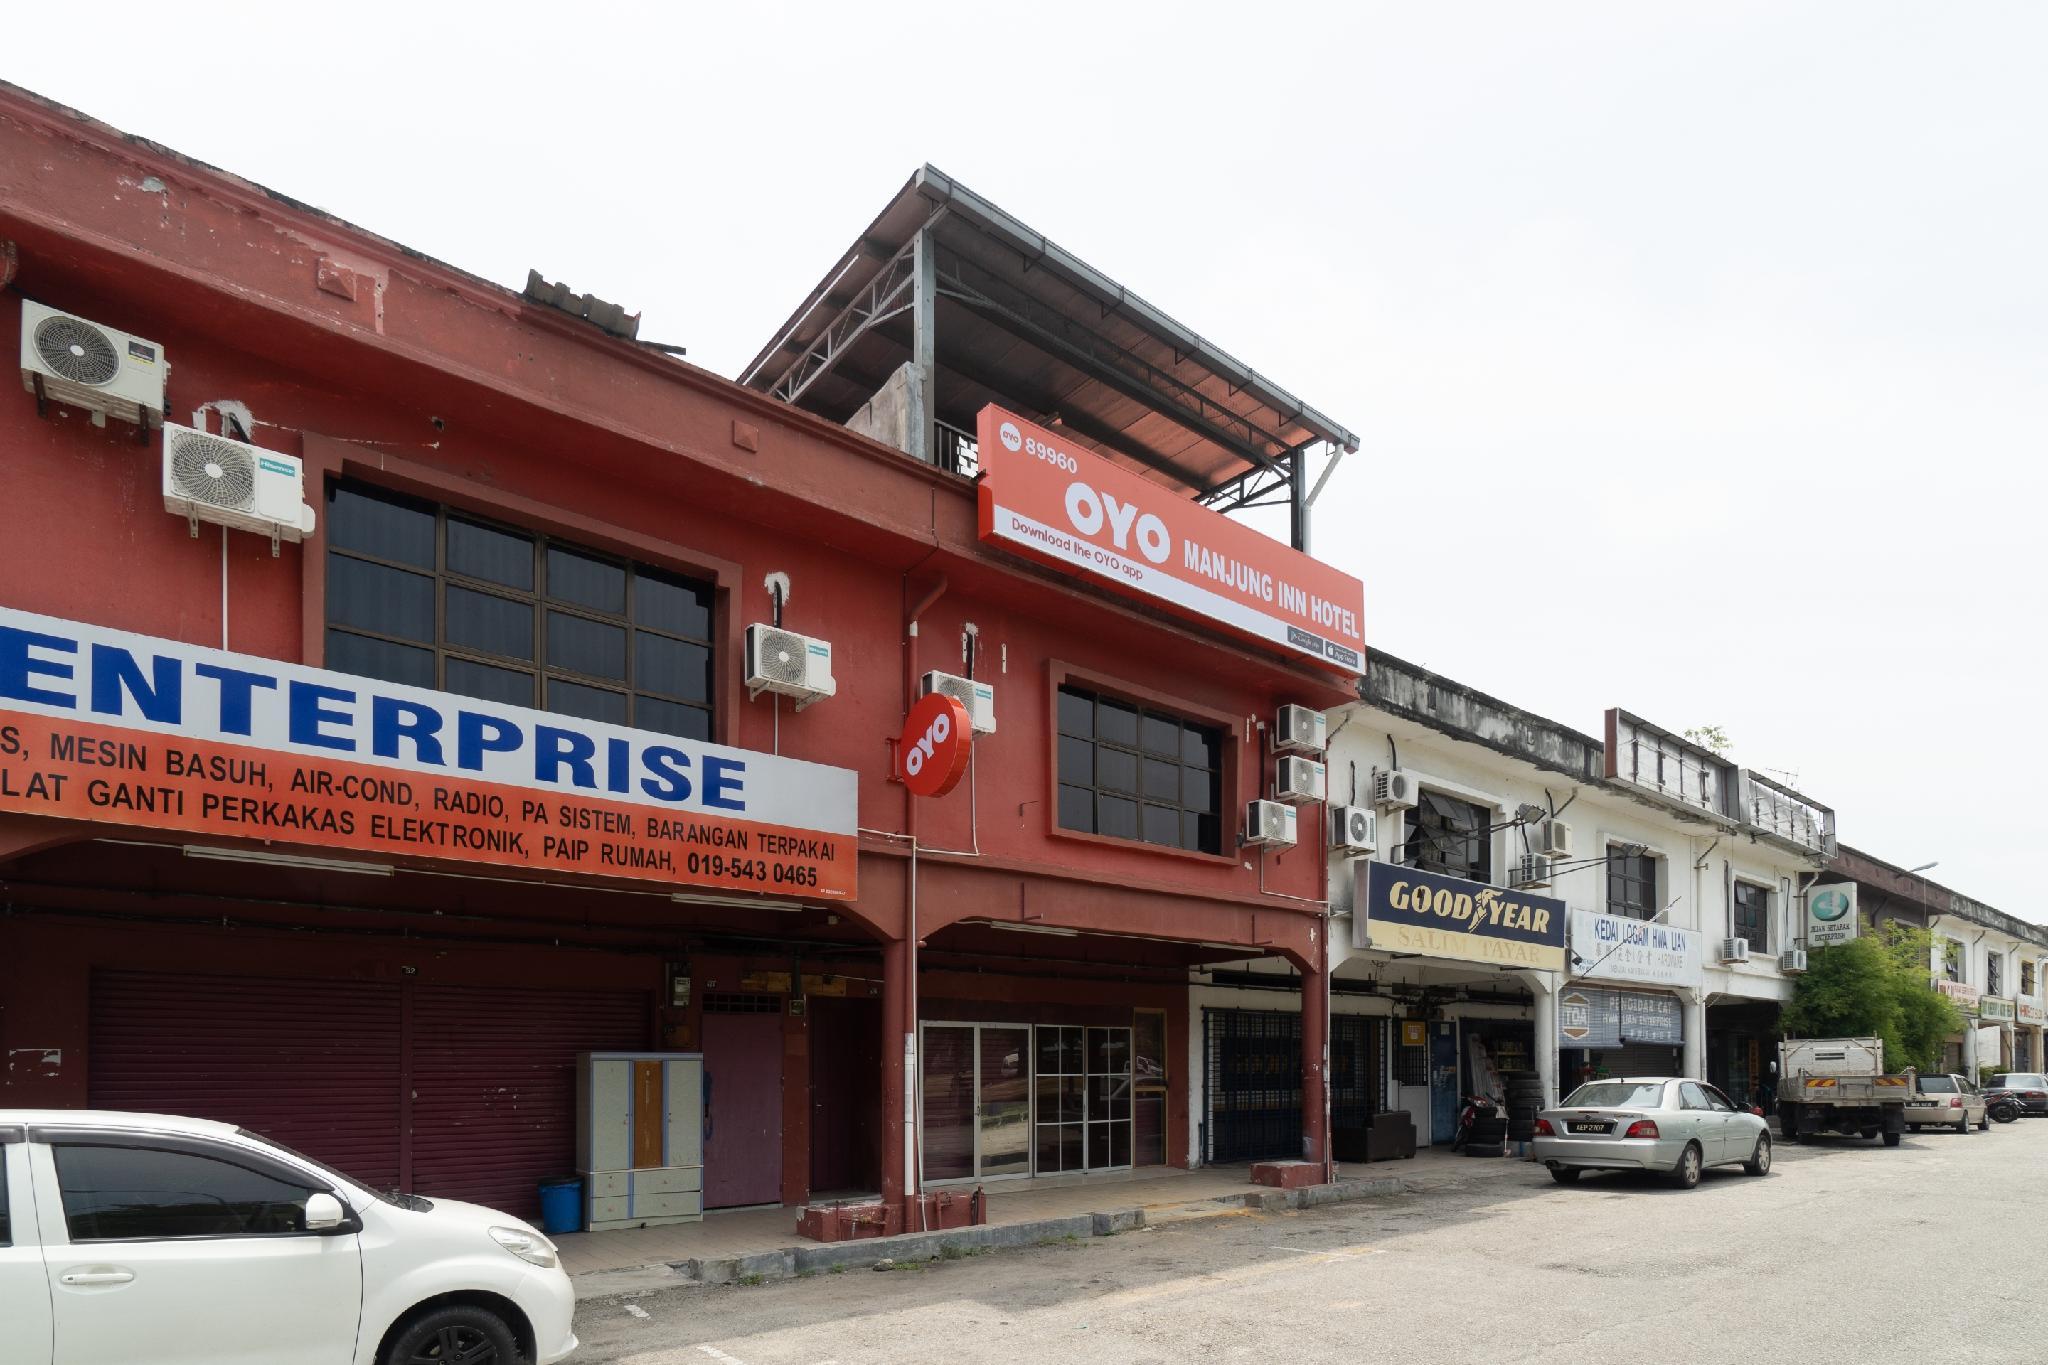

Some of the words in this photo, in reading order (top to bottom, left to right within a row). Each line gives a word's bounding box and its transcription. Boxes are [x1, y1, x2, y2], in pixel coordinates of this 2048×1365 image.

[1002, 431, 1019, 444] OYO
[1025, 437, 1078, 474] 89960
[1012, 517, 1071, 552] Download
[1073, 540, 1092, 560] the
[1095, 551, 1120, 573] OYO
[1122, 562, 1144, 582] app
[1065, 482, 1170, 564] OYO
[1184, 539, 1273, 602] MANJUNG
[1278, 581, 1307, 617] INN
[1311, 594, 1360, 638] HOTEL
[0, 625, 746, 811] ENTERPRISE
[906, 713, 950, 776] OYO
[50, 733, 147, 771] MESIN
[166, 749, 274, 793] BASUH,
[290, 767, 420, 813] AIR-COND,
[434, 786, 509, 823] RADIO,
[522, 800, 549, 826] PA
[559, 804, 636, 840] SISTEM,
[647, 817, 749, 852] BARANGAN
[757, 832, 836, 862] TERPAKAI
[87, 780, 184, 816] GANTI
[202, 793, 356, 836] PERKAKAS
[370, 814, 530, 859] ELEKTRONIK,
[543, 835, 589, 861] PAIP
[601, 842, 677, 876] RUMAH,
[687, 851, 767, 883] 019-543
[773, 858, 818, 888] 0465
[1399, 926, 1467, 953] SALIM
[1594, 918, 1619, 942] KEDAI
[1622, 923, 1649, 947] LOGAM
[1652, 927, 1668, 951] HWA
[1671, 931, 1686, 952] LIAN
